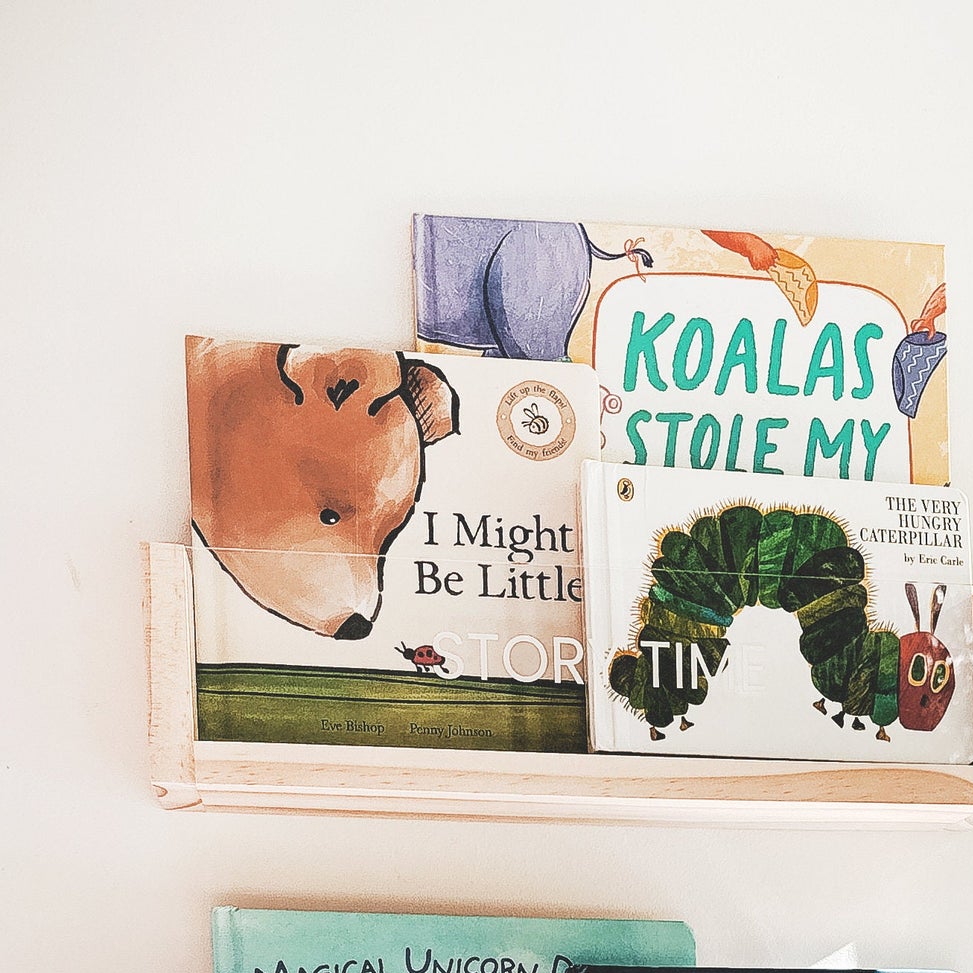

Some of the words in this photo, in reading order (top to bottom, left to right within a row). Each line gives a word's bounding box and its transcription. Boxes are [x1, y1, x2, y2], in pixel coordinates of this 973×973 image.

[622, 311, 884, 400] KOALAS
[505, 392, 518, 406] Lift
[519, 386, 530, 396] up
[533, 385, 546, 394] the
[507, 435, 524, 452] Find
[526, 449, 539, 459] my
[622, 410, 789, 476] STOLE
[803, 417, 891, 482] MY
[885, 496, 917, 512] THE
[920, 499, 961, 515] VERY
[898, 513, 962, 532] HUNGRY
[423, 511, 439, 546] I
[455, 513, 575, 562] Might
[859, 527, 963, 549] CATERPILLAR
[903, 553, 915, 566] by
[918, 554, 938, 565] Eric
[940, 555, 964, 567] Carle
[414, 560, 464, 597] Be
[478, 564, 583, 602] Little
[432, 631, 612, 685] STOR
[320, 719, 343, 732] Eve
[345, 720, 385, 735] Bishop
[409, 722, 444, 739] Penny
[446, 725, 494, 739] Johnson
